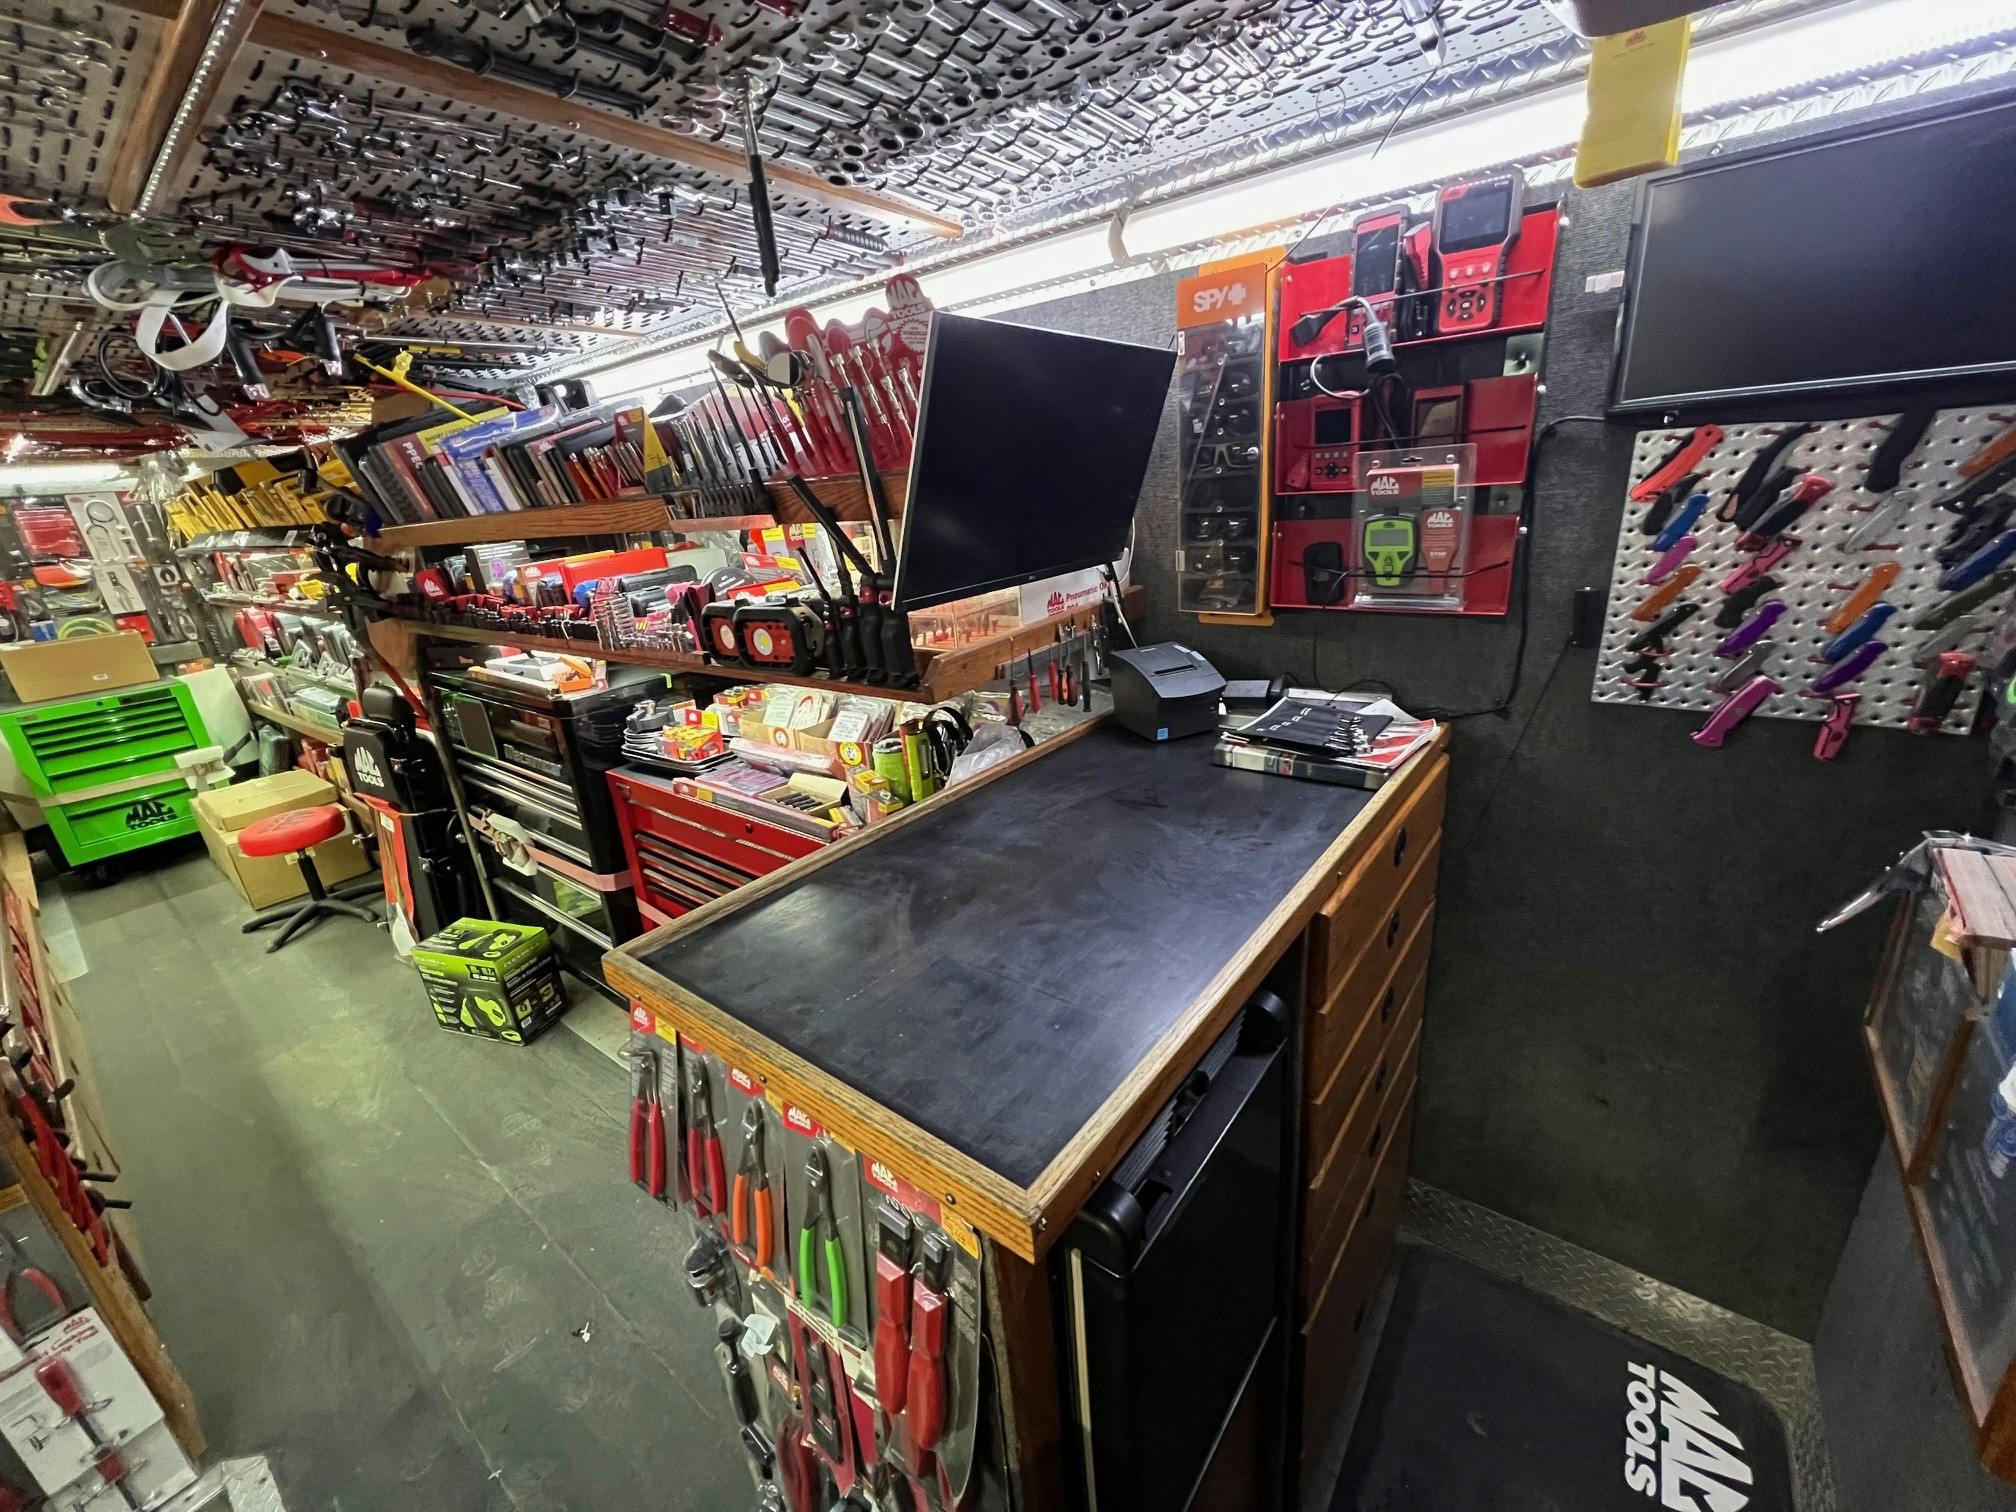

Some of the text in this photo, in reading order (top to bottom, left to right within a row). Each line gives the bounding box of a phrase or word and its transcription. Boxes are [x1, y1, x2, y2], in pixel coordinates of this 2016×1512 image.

[1193, 285, 1229, 313] SPY
[891, 304, 925, 319] TOOLS
[1370, 476, 1399, 489] MAC
[1427, 511, 1453, 523] MAC
[1047, 591, 1064, 608] MAC
[1066, 586, 1098, 601] Pneumatic
[354, 746, 382, 778] MAC
[357, 771, 384, 788] TOOLS
[126, 801, 175, 827] MAC
[128, 813, 178, 830] TOOLS
[1624, 1361, 1657, 1498] TOOLS
[1659, 1369, 1754, 1512] MAC
